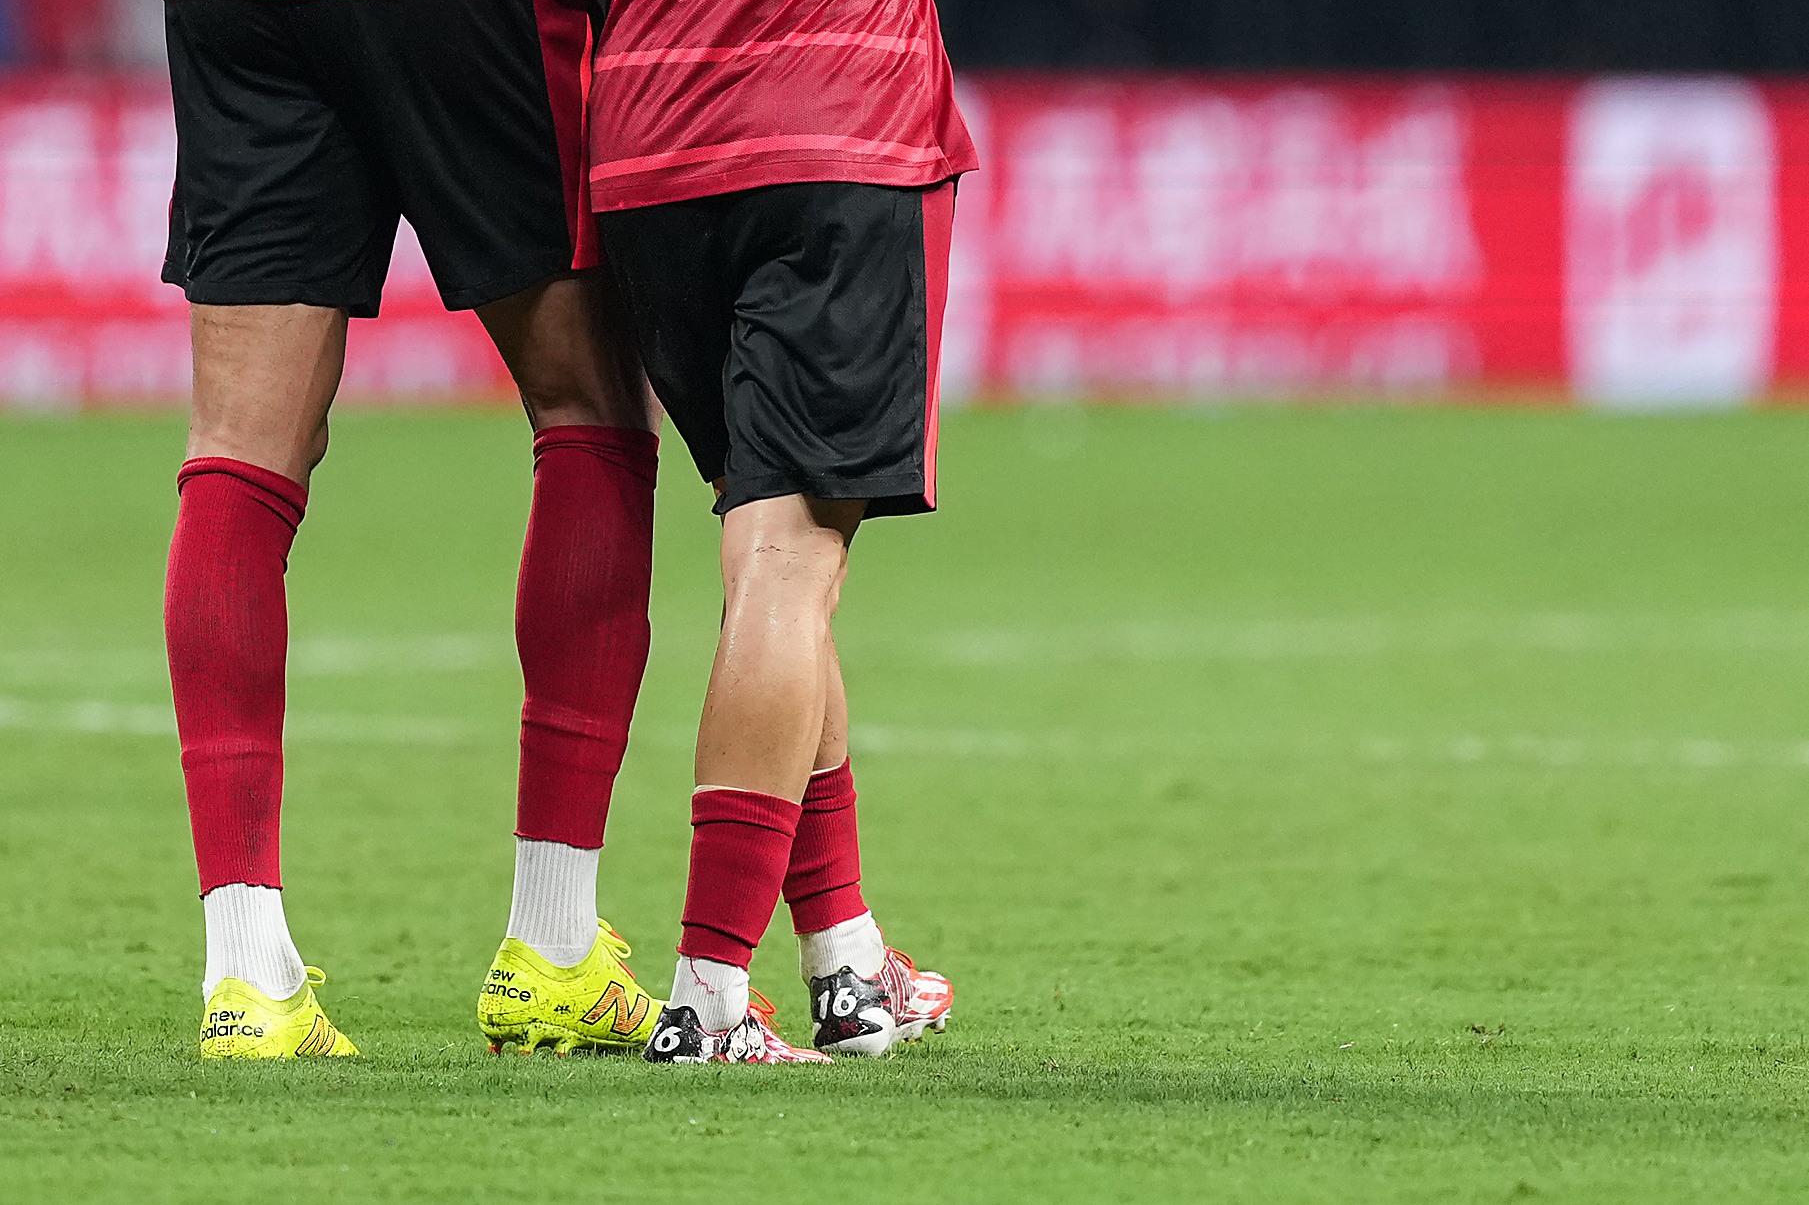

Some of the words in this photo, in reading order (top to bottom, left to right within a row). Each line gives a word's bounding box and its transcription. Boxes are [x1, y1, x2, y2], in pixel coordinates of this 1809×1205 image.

[491, 968, 516, 982] ew
[580, 980, 650, 1036] N
[817, 986, 858, 1018] 16
[209, 1010, 246, 1024] new
